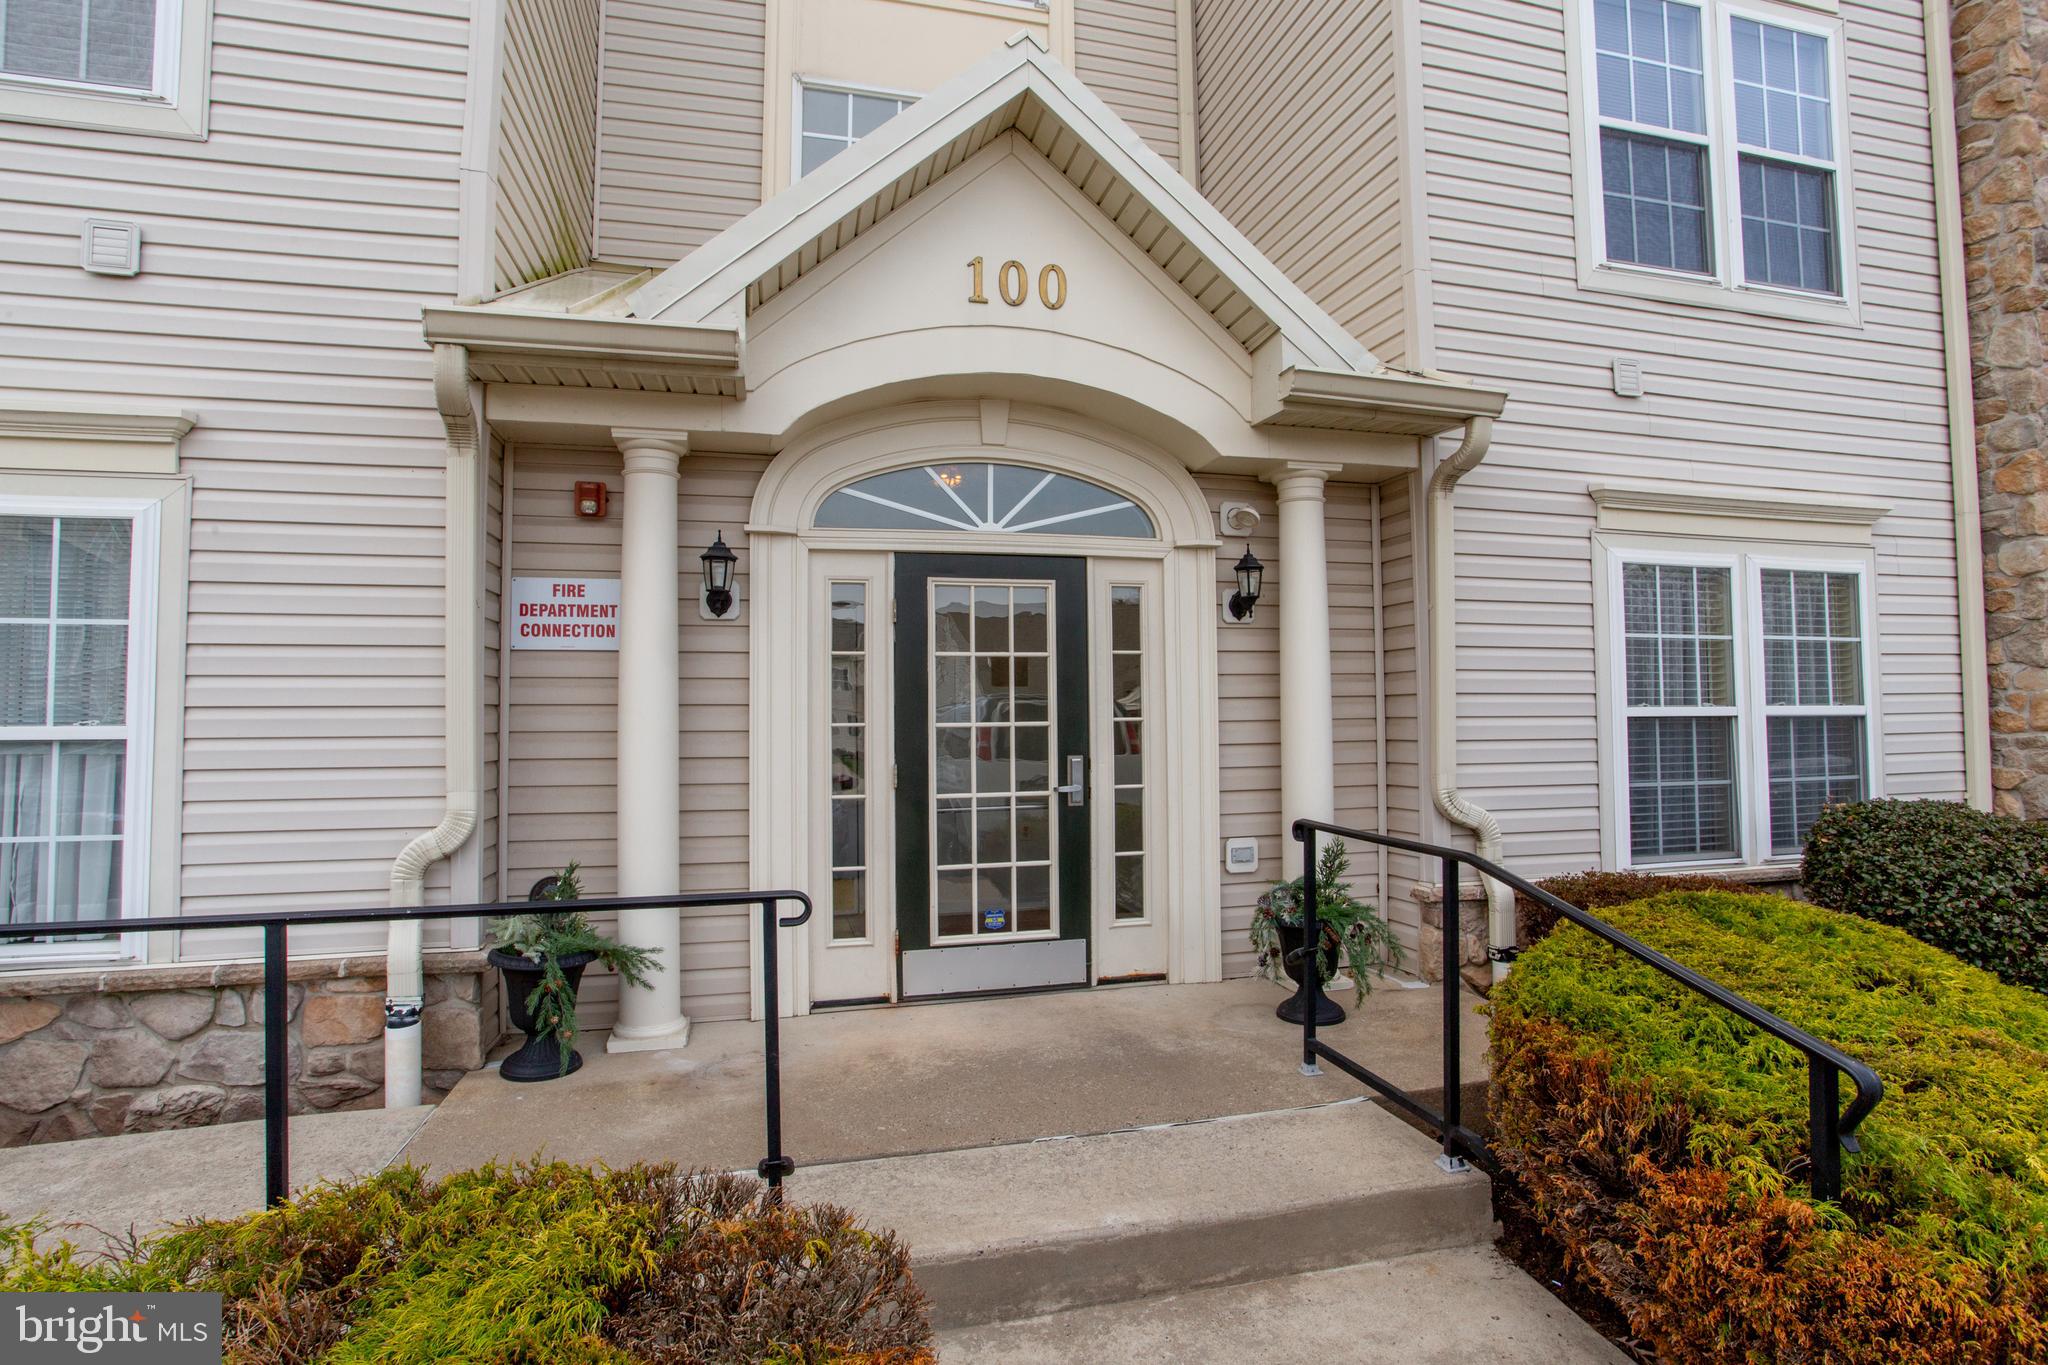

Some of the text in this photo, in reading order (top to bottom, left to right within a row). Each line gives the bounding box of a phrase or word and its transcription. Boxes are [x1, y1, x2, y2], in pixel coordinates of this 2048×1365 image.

[967, 256, 1067, 310] 100
[552, 583, 586, 598] FIRE
[519, 603, 618, 618] DEPARTMENT
[520, 623, 616, 638] CONNECTION
